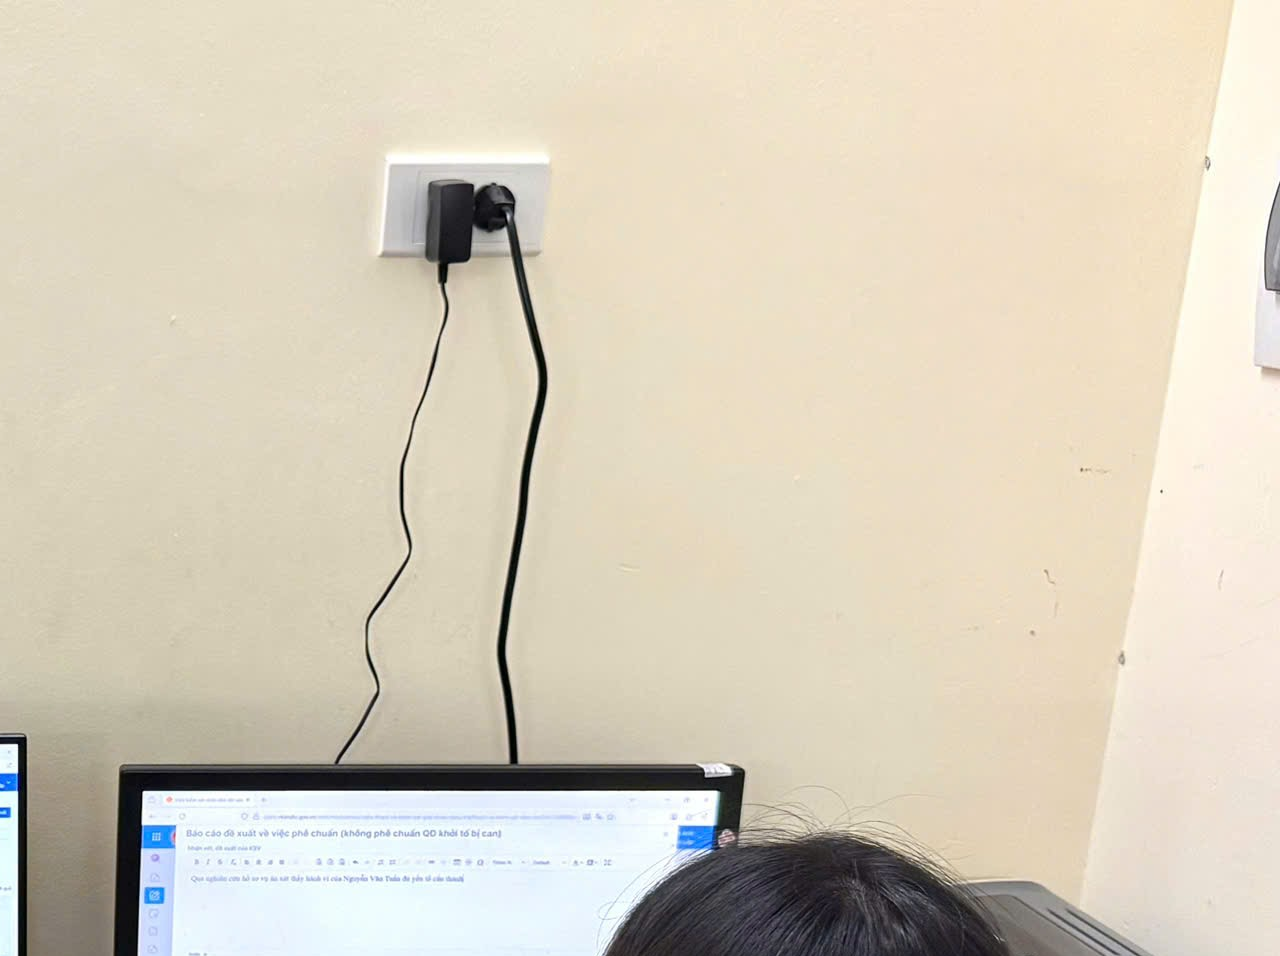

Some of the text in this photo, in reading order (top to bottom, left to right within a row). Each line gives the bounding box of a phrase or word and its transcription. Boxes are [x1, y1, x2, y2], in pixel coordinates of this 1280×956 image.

[186, 829, 203, 837] Báo
[223, 828, 234, 837] đề
[237, 829, 256, 837] xuất
[258, 828, 269, 837] về
[271, 828, 289, 838] việc
[291, 829, 308, 838] phê
[340, 828, 372, 839] (không
[373, 829, 390, 838] phê
[470, 828, 480, 839] bị
[481, 829, 502, 838] can)
